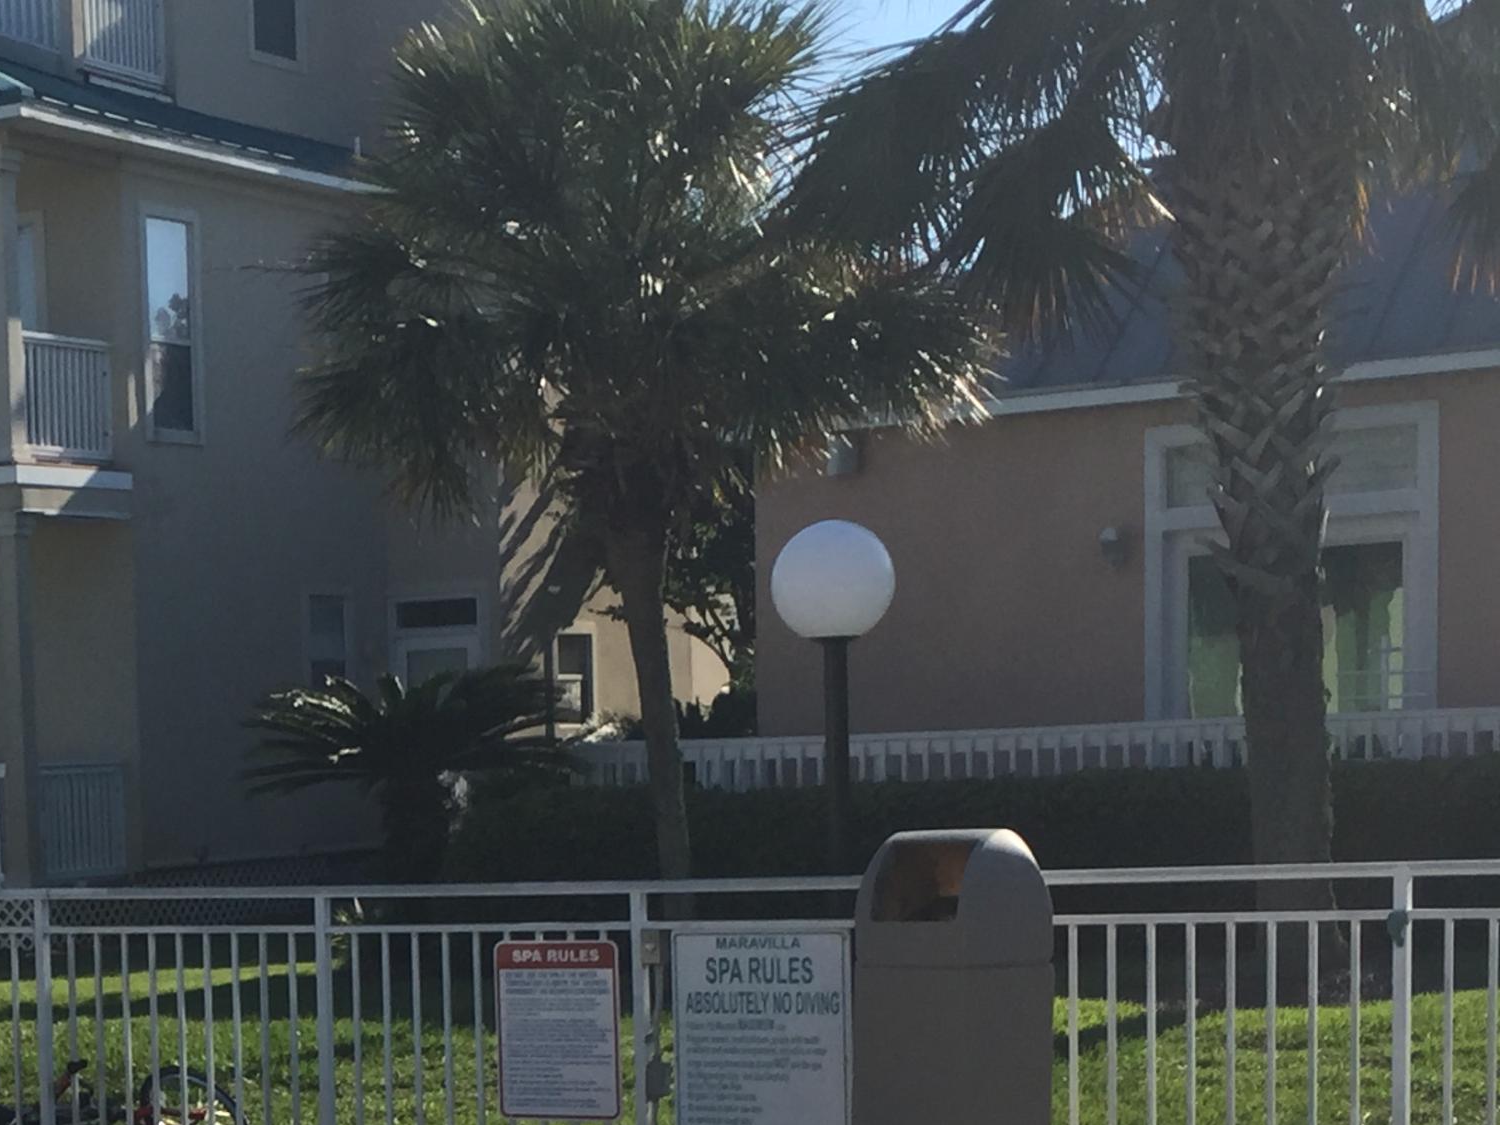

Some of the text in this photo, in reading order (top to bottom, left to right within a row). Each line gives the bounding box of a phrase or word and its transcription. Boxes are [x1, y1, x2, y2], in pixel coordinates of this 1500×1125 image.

[715, 937, 801, 950] MARAVILLA
[512, 948, 600, 963] SPA RULES
[705, 956, 814, 985] SPA RULES
[685, 991, 840, 1016] ABSOLUTELY NO DIVING
